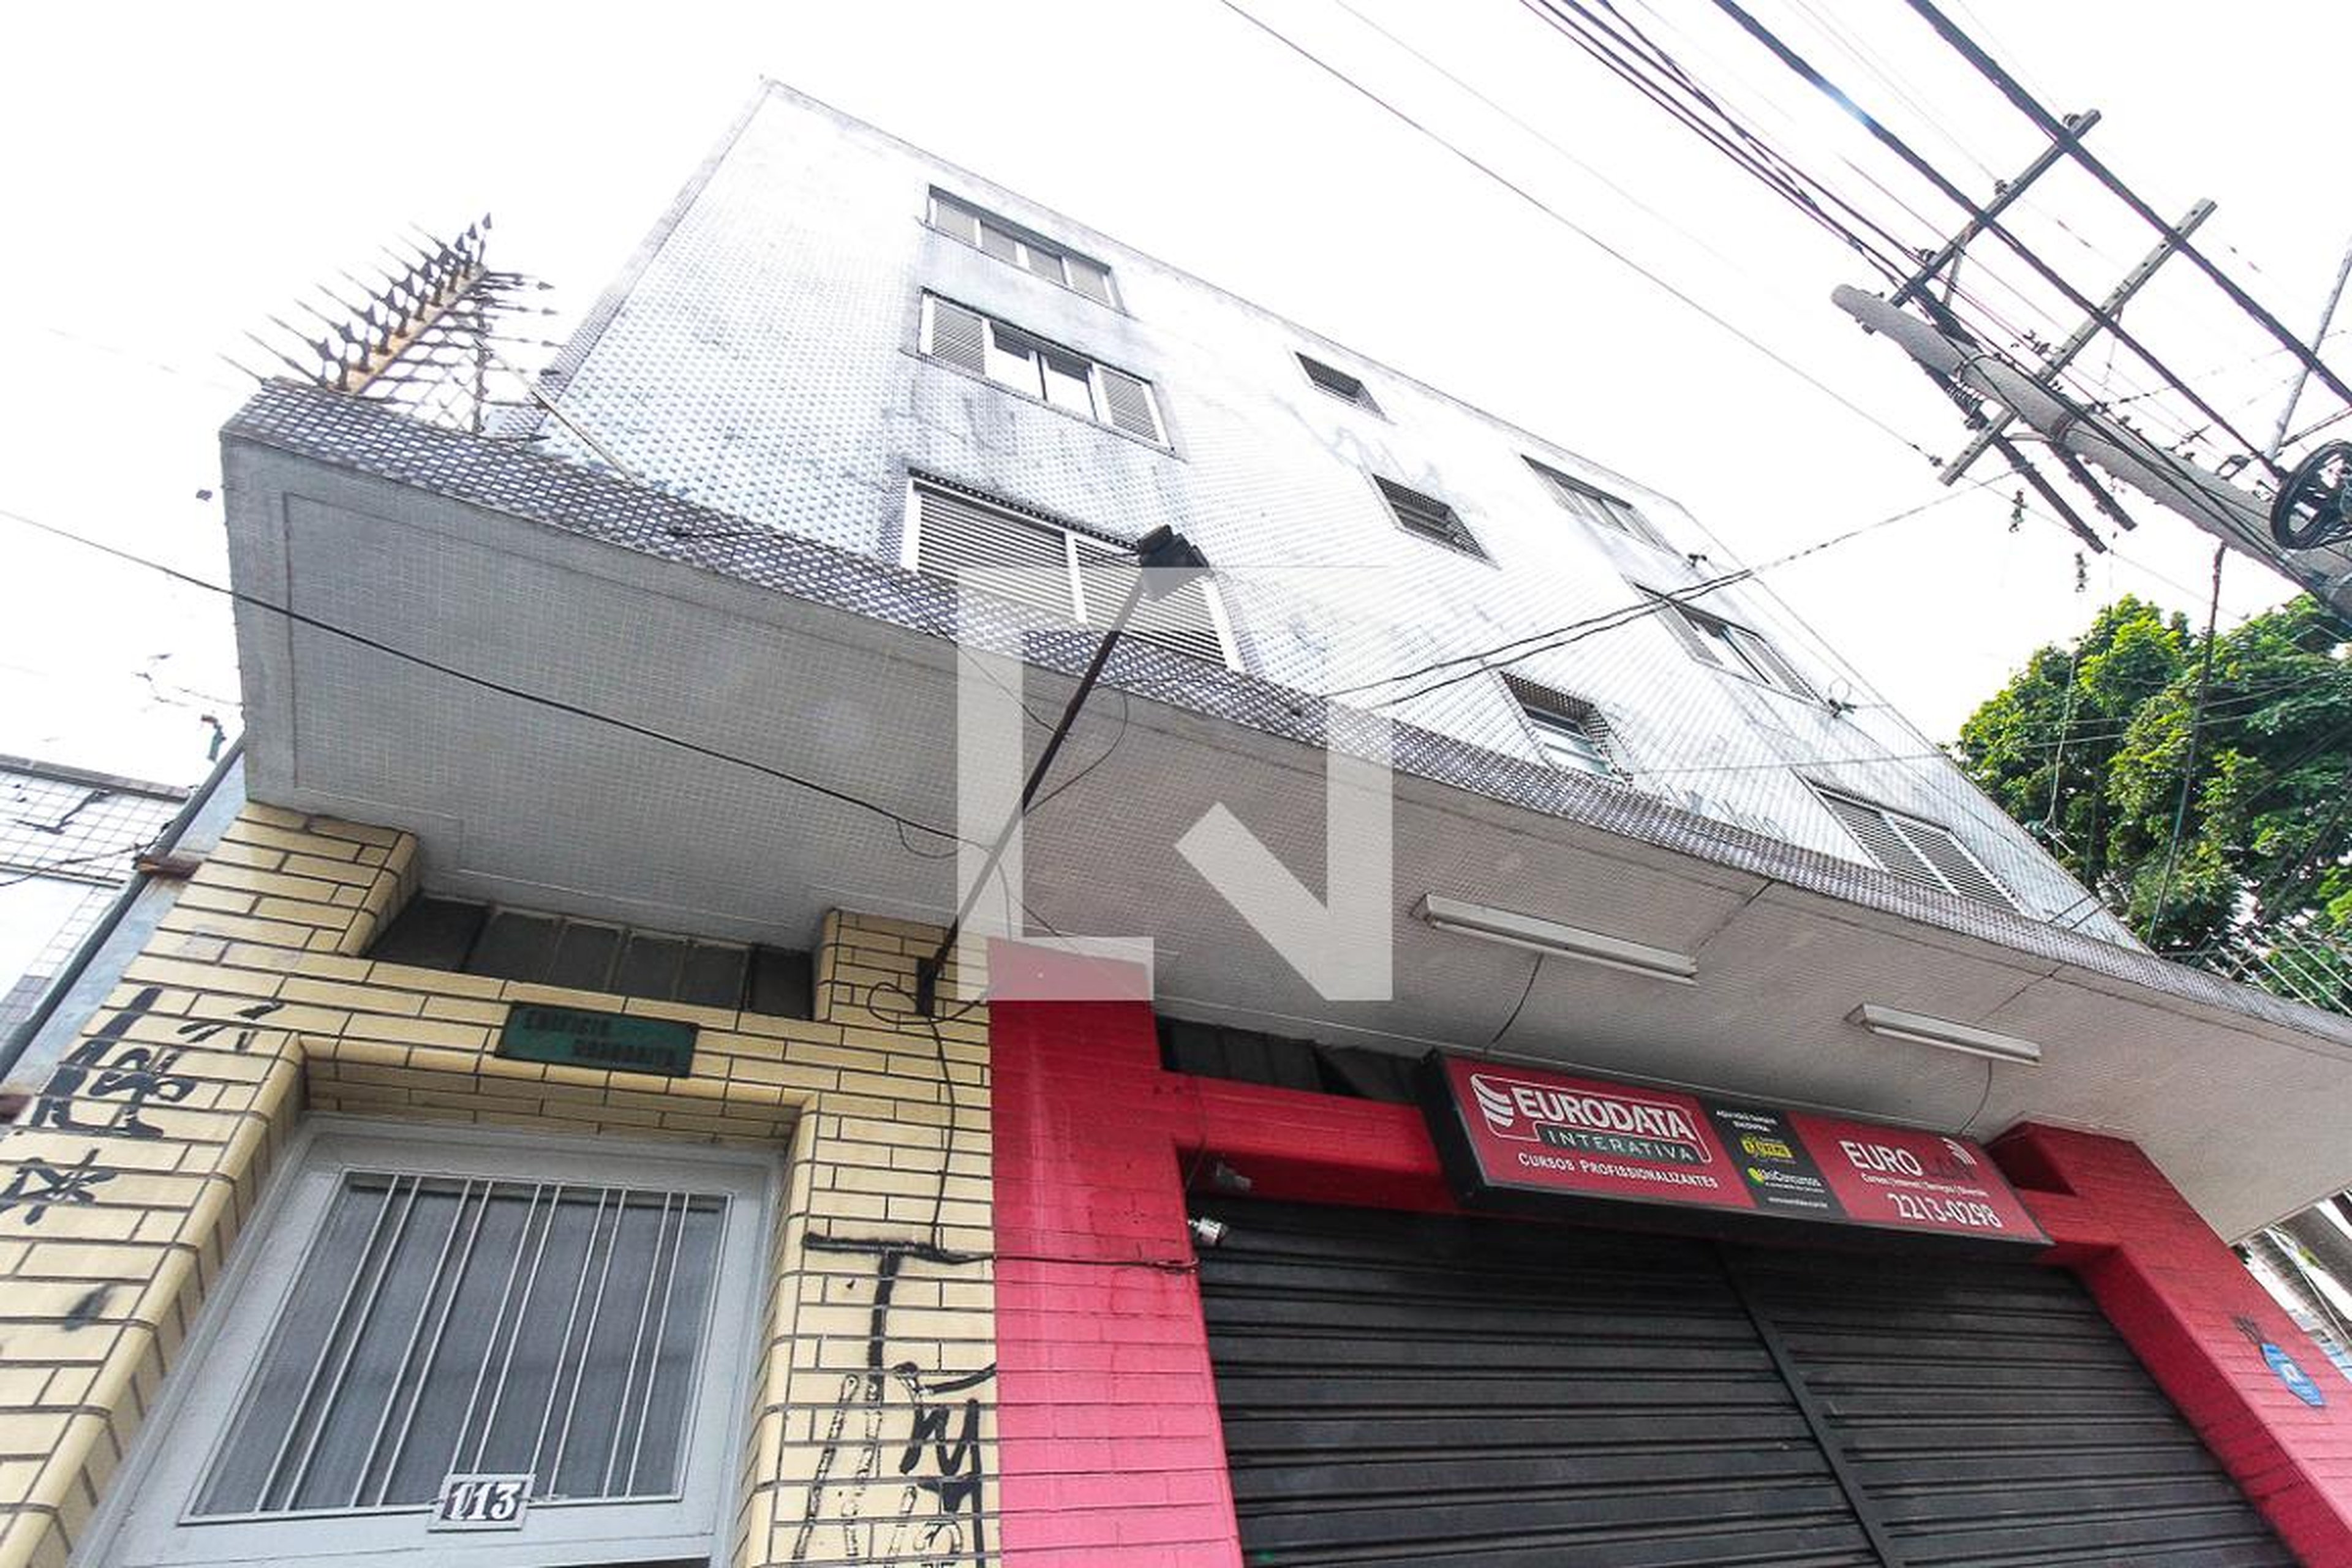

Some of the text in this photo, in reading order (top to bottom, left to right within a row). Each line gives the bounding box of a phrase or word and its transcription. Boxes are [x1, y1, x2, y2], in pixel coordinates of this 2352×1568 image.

[1510, 1087, 1697, 1141] EURODATA
[1518, 1152, 1575, 1171] CURSOS
[1547, 1130, 1695, 1161] INTERATIVA
[1887, 1192, 2003, 1229] 2213-0298
[447, 1482, 522, 1520] 113
